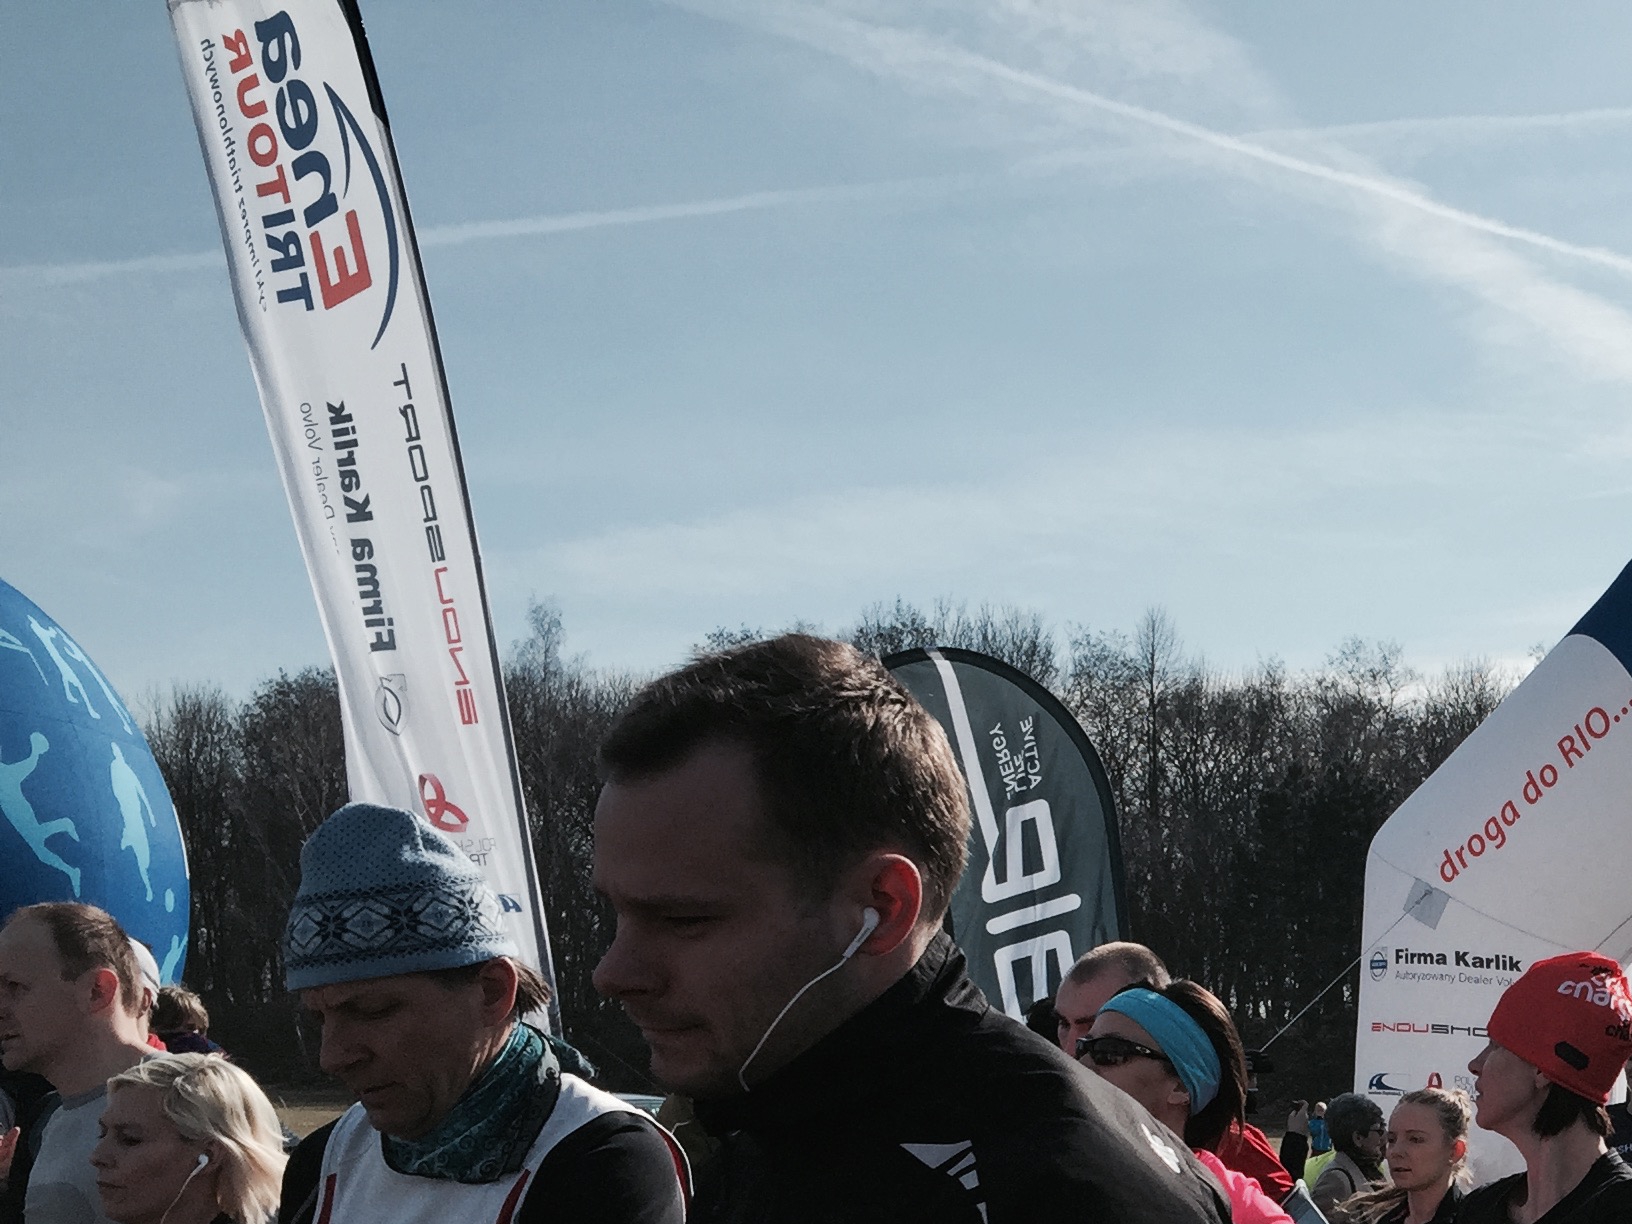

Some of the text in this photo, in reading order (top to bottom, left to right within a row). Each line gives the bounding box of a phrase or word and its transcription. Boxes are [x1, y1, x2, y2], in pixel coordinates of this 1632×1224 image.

[1438, 799, 1522, 883] droga
[1521, 762, 1558, 806] do
[1395, 948, 1522, 972] Firma Karlik
[1395, 970, 1455, 984] Autoryzowany
[1459, 973, 1493, 985] Dealer
